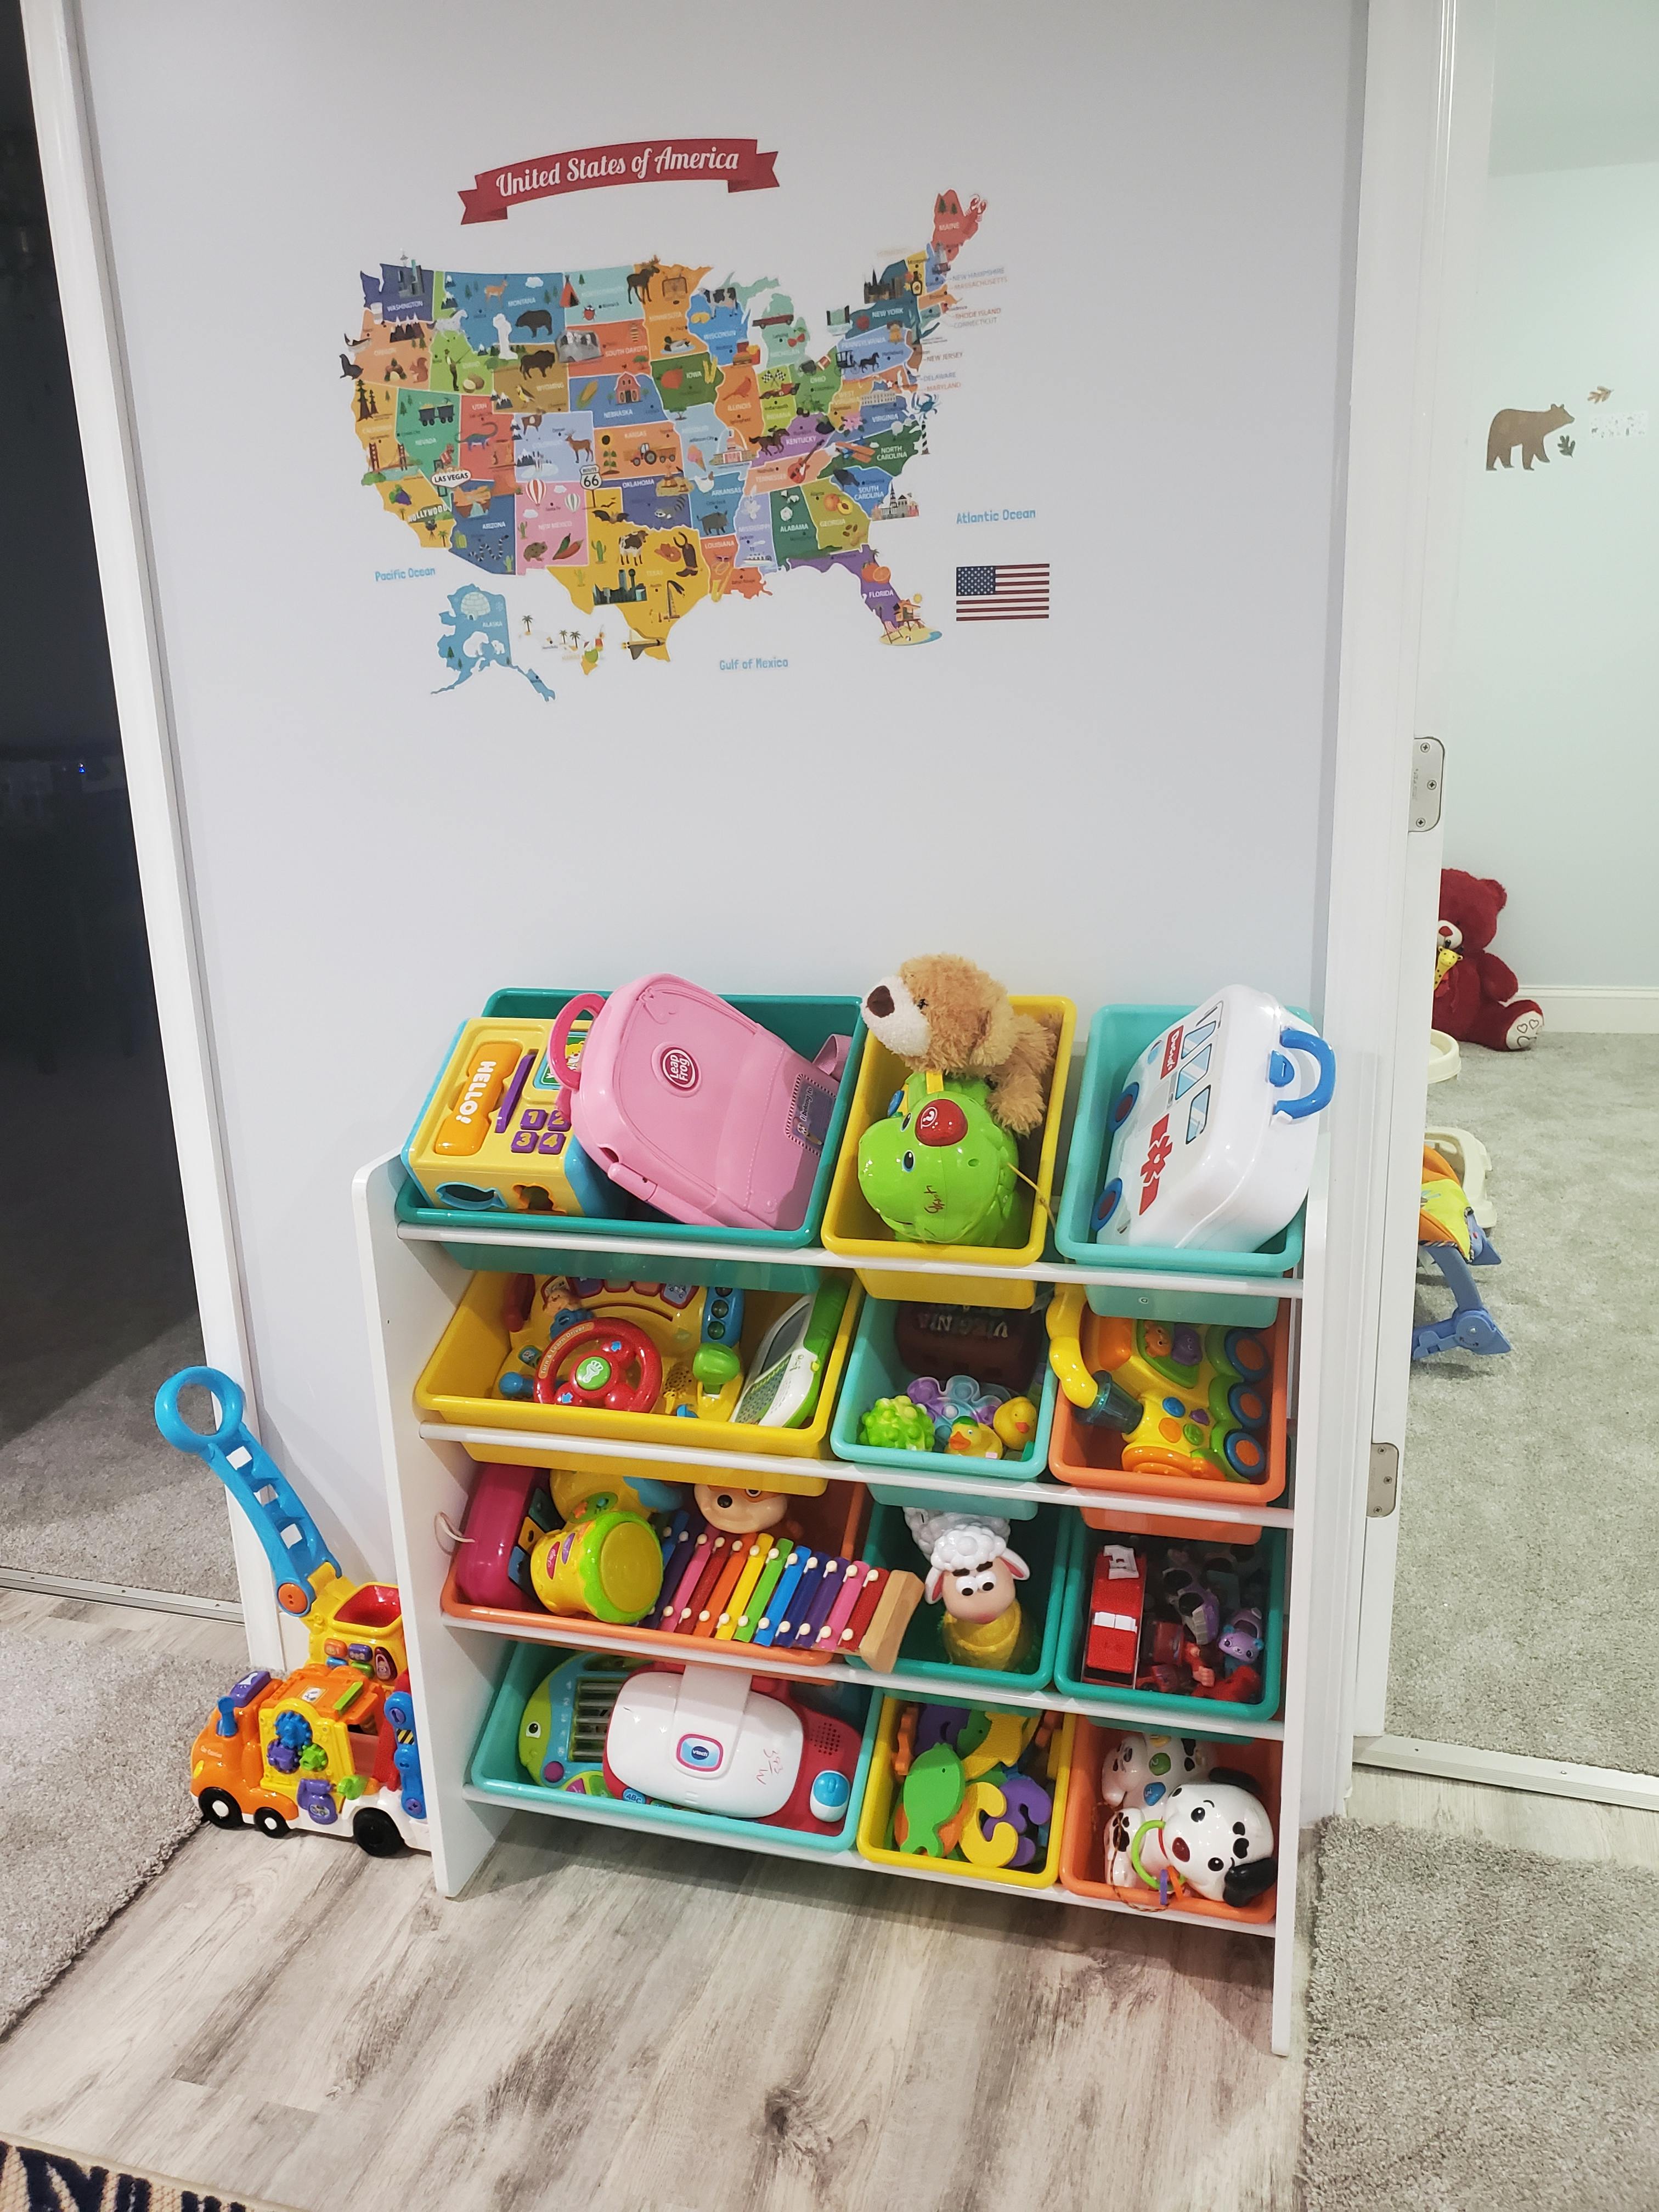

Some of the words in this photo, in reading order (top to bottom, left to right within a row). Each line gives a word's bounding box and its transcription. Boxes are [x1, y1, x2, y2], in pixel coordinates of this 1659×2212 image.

[496, 162, 560, 196] United
[567, 154, 625, 182] States
[632, 148, 653, 179] of
[654, 146, 739, 173] America
[939, 222, 960, 231] MAINE
[387, 301, 423, 312] WASHINGTON
[508, 297, 536, 307] MONTANA
[887, 308, 904, 317] YORK
[955, 312, 978, 320] RHODE
[978, 308, 1001, 318] ISLAND
[703, 330, 736, 340] WISCONSIN
[606, 347, 625, 357] SOUTH
[625, 345, 648, 355] DAKOTA
[603, 409, 633, 419] NEBRASKA
[872, 414, 899, 423] VIRGINIA
[786, 436, 816, 445] KENTUCKY
[877, 452, 907, 461] CAROLINA
[434, 475, 447, 484] LAS
[447, 472, 469, 482] VEGAS
[584, 476, 599, 487] 66
[622, 478, 654, 489] OKLAHOMA
[858, 486, 879, 494] SOUTH
[854, 492, 884, 500] CAROLINA
[408, 504, 448, 522] HOLLYWOOD
[956, 511, 999, 524] Atlantic
[1002, 509, 1036, 521] Ocean
[482, 521, 506, 529] ARIZONA
[780, 523, 809, 533] ALABAMA
[704, 540, 735, 549] LOUISIANA
[375, 569, 407, 582] Pacific
[408, 567, 436, 578] Ocean
[869, 589, 894, 599] FLORIDA
[719, 659, 739, 670] Gulf
[742, 658, 753, 670] of
[756, 657, 789, 669] Mexico
[669, 1054, 680, 1079] Leap
[679, 1057, 690, 1082] Frog
[456, 1061, 496, 1124] HELLO!
[806, 1086, 813, 1096] to
[801, 1094, 812, 1116] belong
[529, 1111, 539, 1124] 1
[516, 1133, 532, 1147] 3
[543, 1134, 557, 1147] 4
[540, 1360, 550, 1373] Turn
[550, 1338, 566, 1353] Learn
[566, 1326, 584, 1338] Driver
[692, 1749, 708, 1757] vtech
[625, 1793, 642, 1804] ABC
